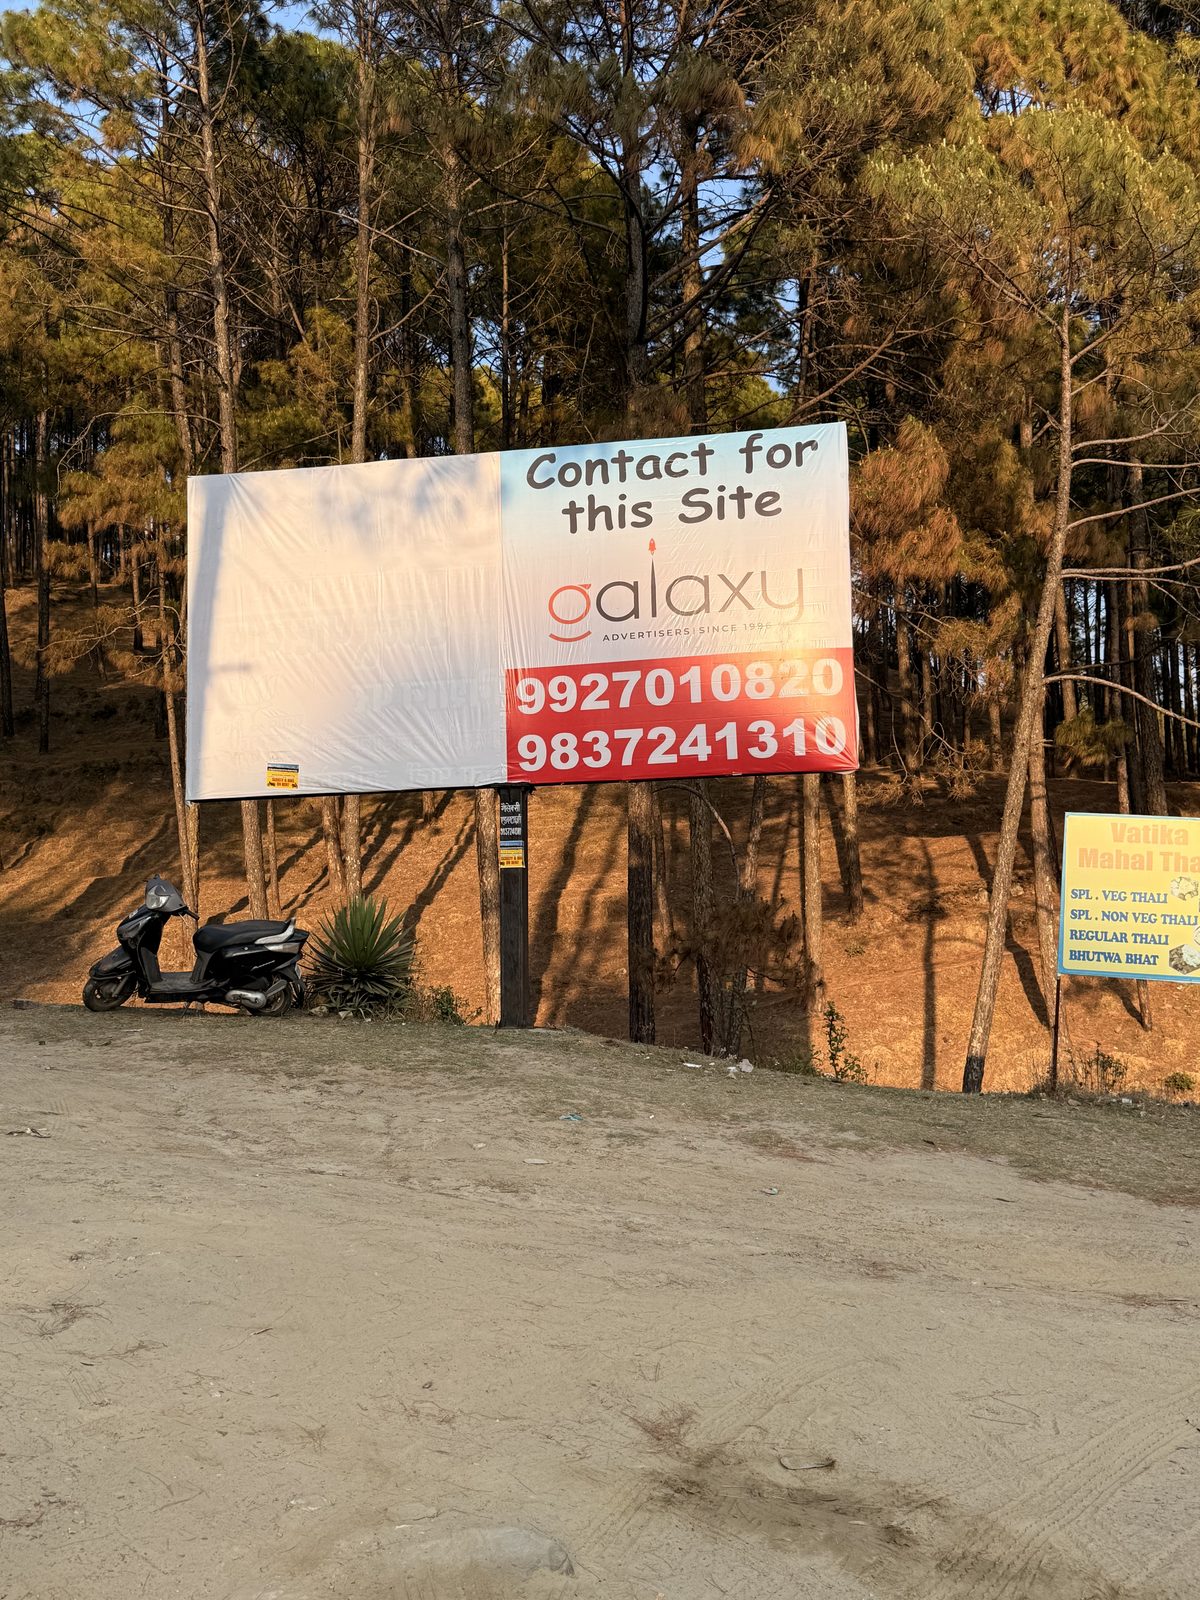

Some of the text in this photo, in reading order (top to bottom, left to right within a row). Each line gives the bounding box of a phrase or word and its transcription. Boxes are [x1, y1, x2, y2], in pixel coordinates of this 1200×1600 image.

[527, 433, 819, 490] Contact for
[562, 484, 782, 534] this Site
[548, 558, 804, 643] galaxy
[602, 628, 691, 643] ADVERTISERS
[698, 624, 737, 634] SINCE
[516, 658, 844, 715] 9927010820
[517, 716, 846, 772] 9837241310
[1111, 822, 1189, 846] Vatika
[1078, 847, 1153, 871] Mahal
[1102, 890, 1128, 902] VEG
[1130, 892, 1168, 904] THALI
[1101, 911, 1129, 922] NON
[1132, 912, 1158, 924] VEG
[1160, 914, 1199, 926] THALI
[1069, 930, 1169, 946] REGULAR THALI
[1069, 950, 1160, 966] BHUTWA BHAT
